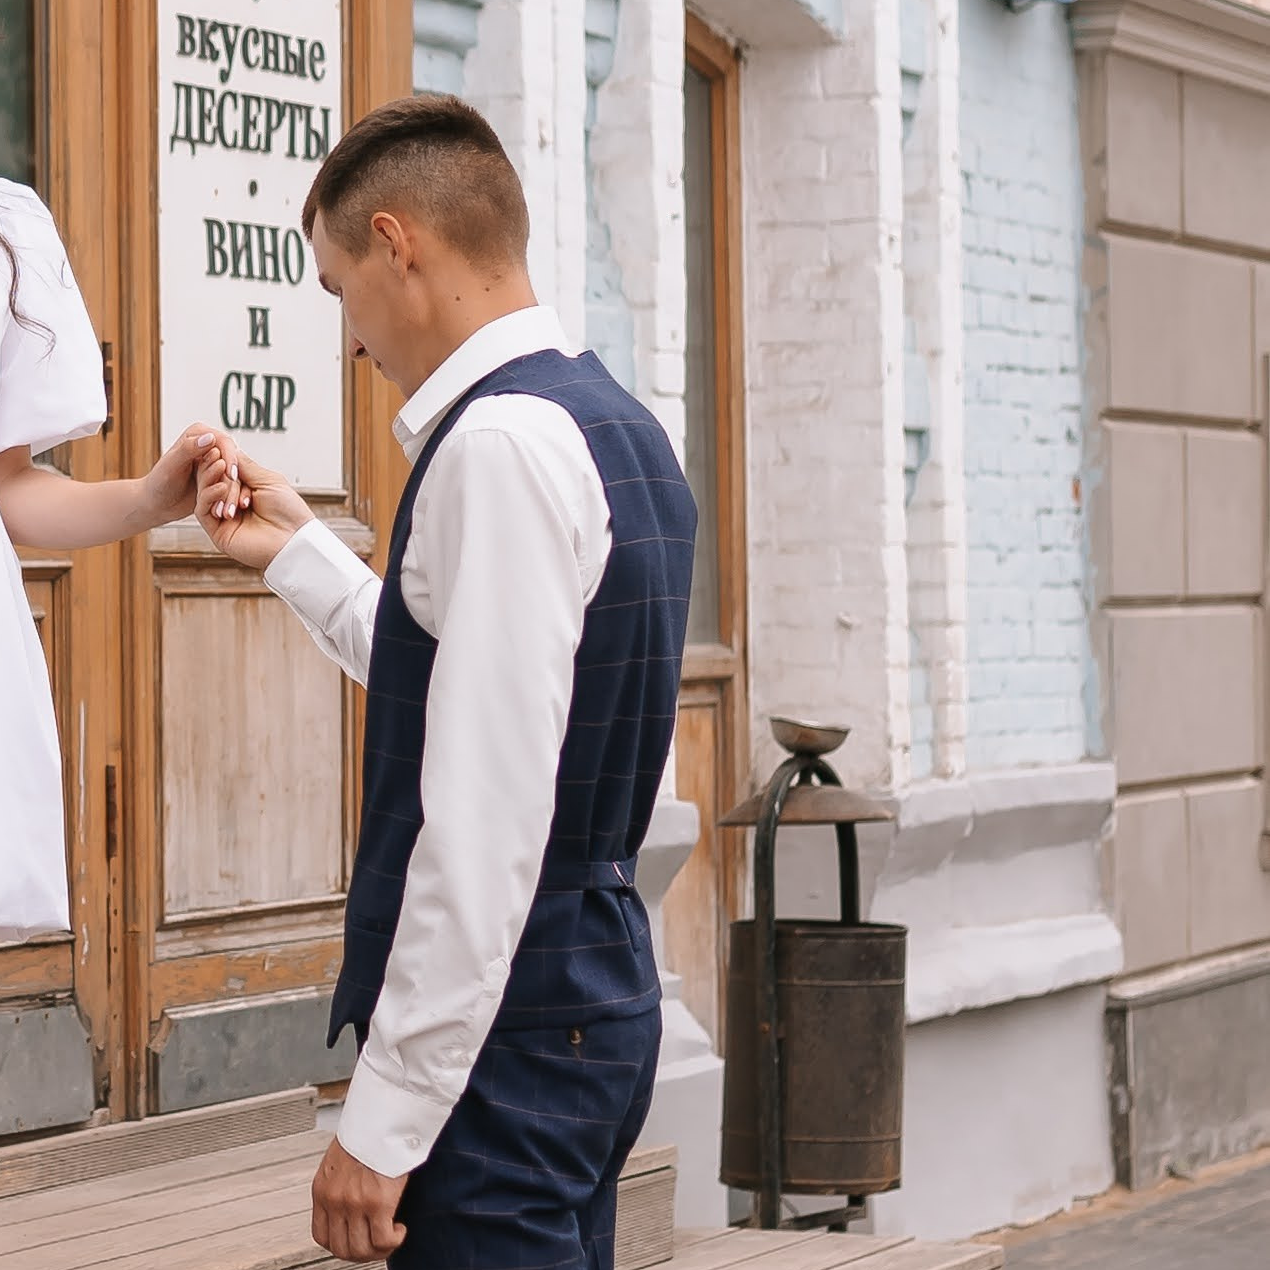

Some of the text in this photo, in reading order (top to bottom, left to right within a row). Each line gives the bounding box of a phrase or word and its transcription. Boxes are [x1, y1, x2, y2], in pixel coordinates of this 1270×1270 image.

[170, 82, 331, 161] ДЕСЕРТЫ
[204, 218, 305, 285] ВИНО
[220, 371, 296, 431] СЫР
